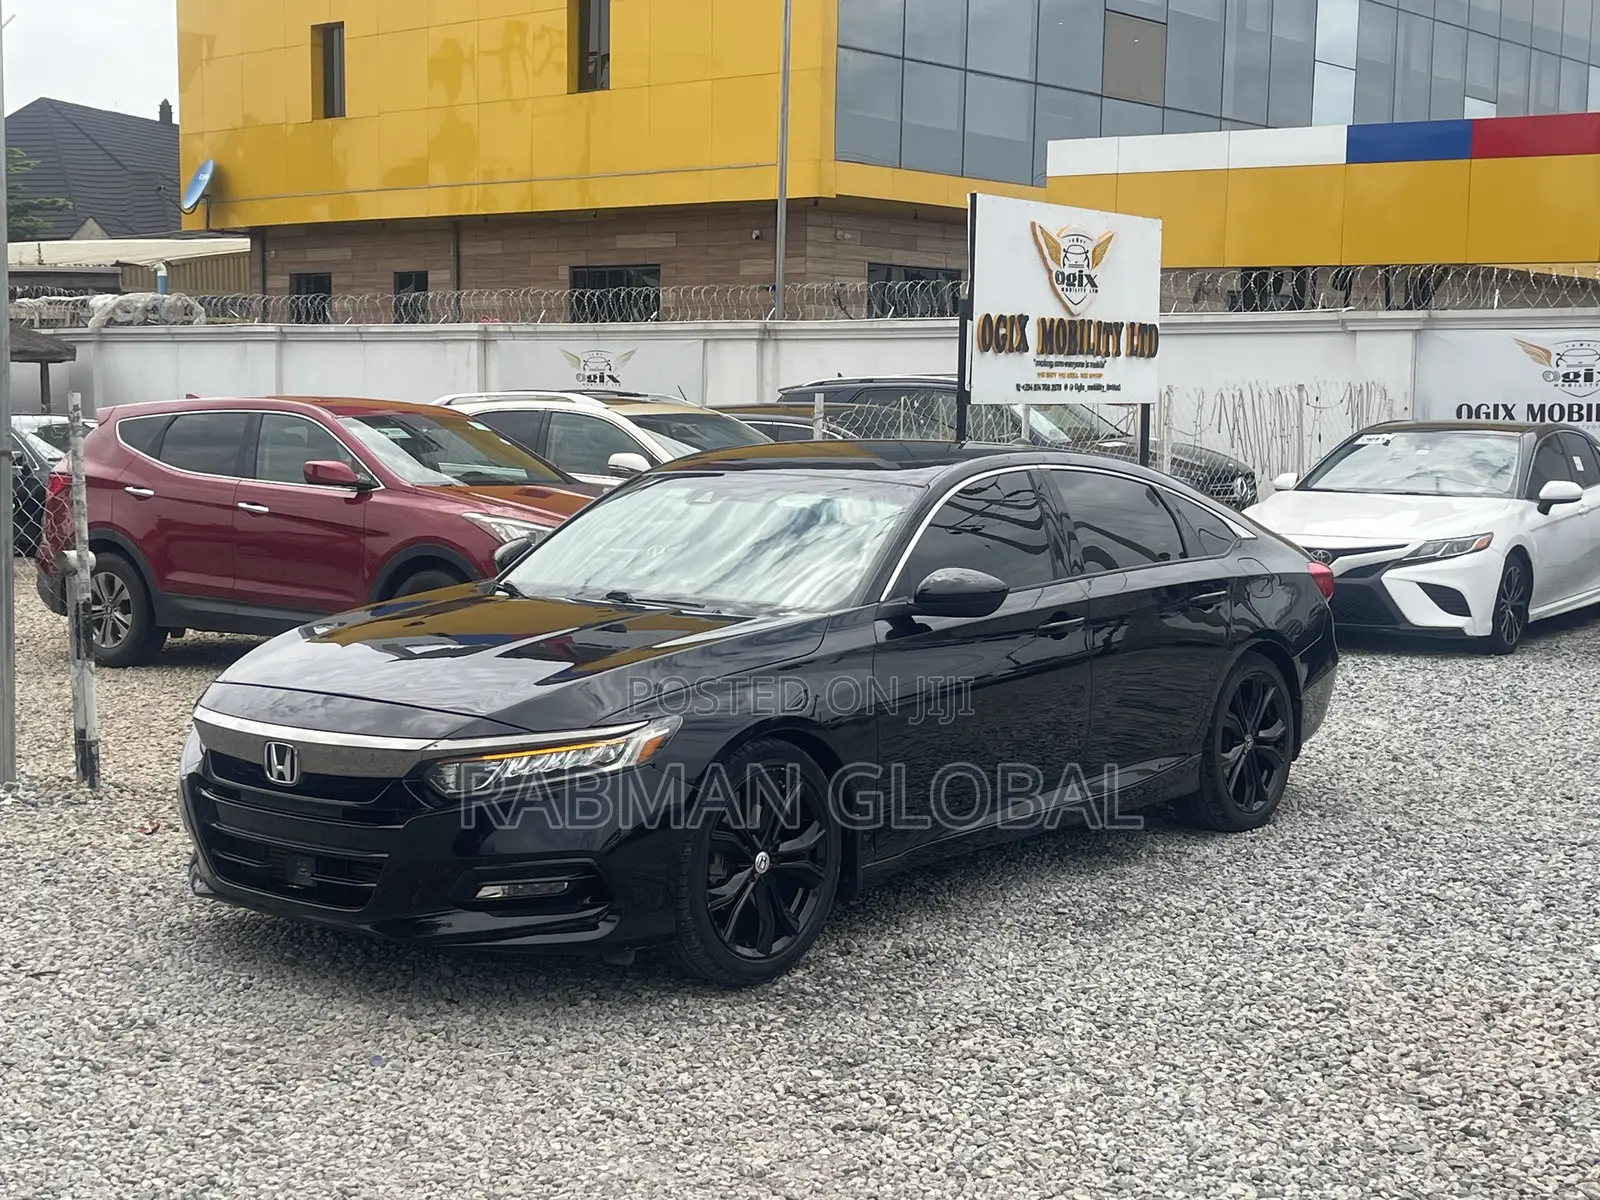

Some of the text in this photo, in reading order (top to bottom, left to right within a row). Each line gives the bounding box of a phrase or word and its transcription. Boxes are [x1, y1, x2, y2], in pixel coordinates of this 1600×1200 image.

[977, 313, 1159, 358] OGIX MOBILITY LTD
[1456, 403, 1516, 420] OGIX
